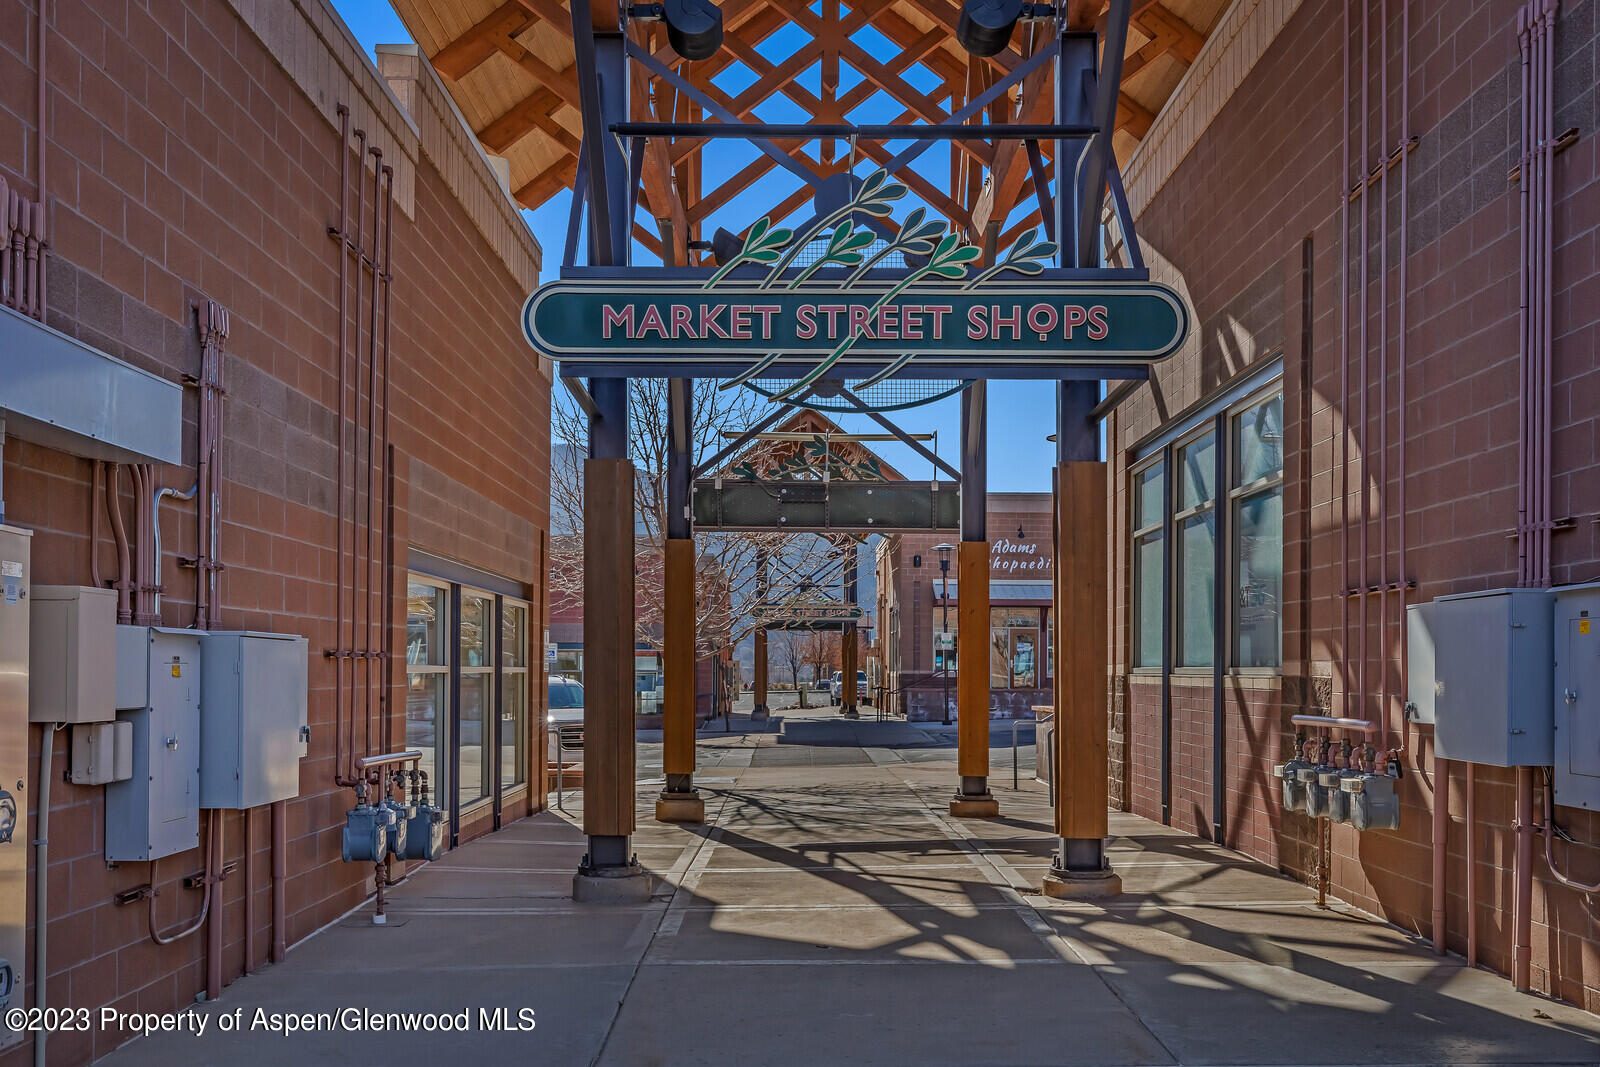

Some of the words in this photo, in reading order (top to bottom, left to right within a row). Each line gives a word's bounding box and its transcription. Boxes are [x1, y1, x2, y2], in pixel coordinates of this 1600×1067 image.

[602, 304, 781, 339] MARKET
[796, 304, 952, 340] STREET
[967, 304, 1109, 341] SHOPS
[991, 538, 1037, 554] Adams
[989, 556, 1053, 573] hopaedi
